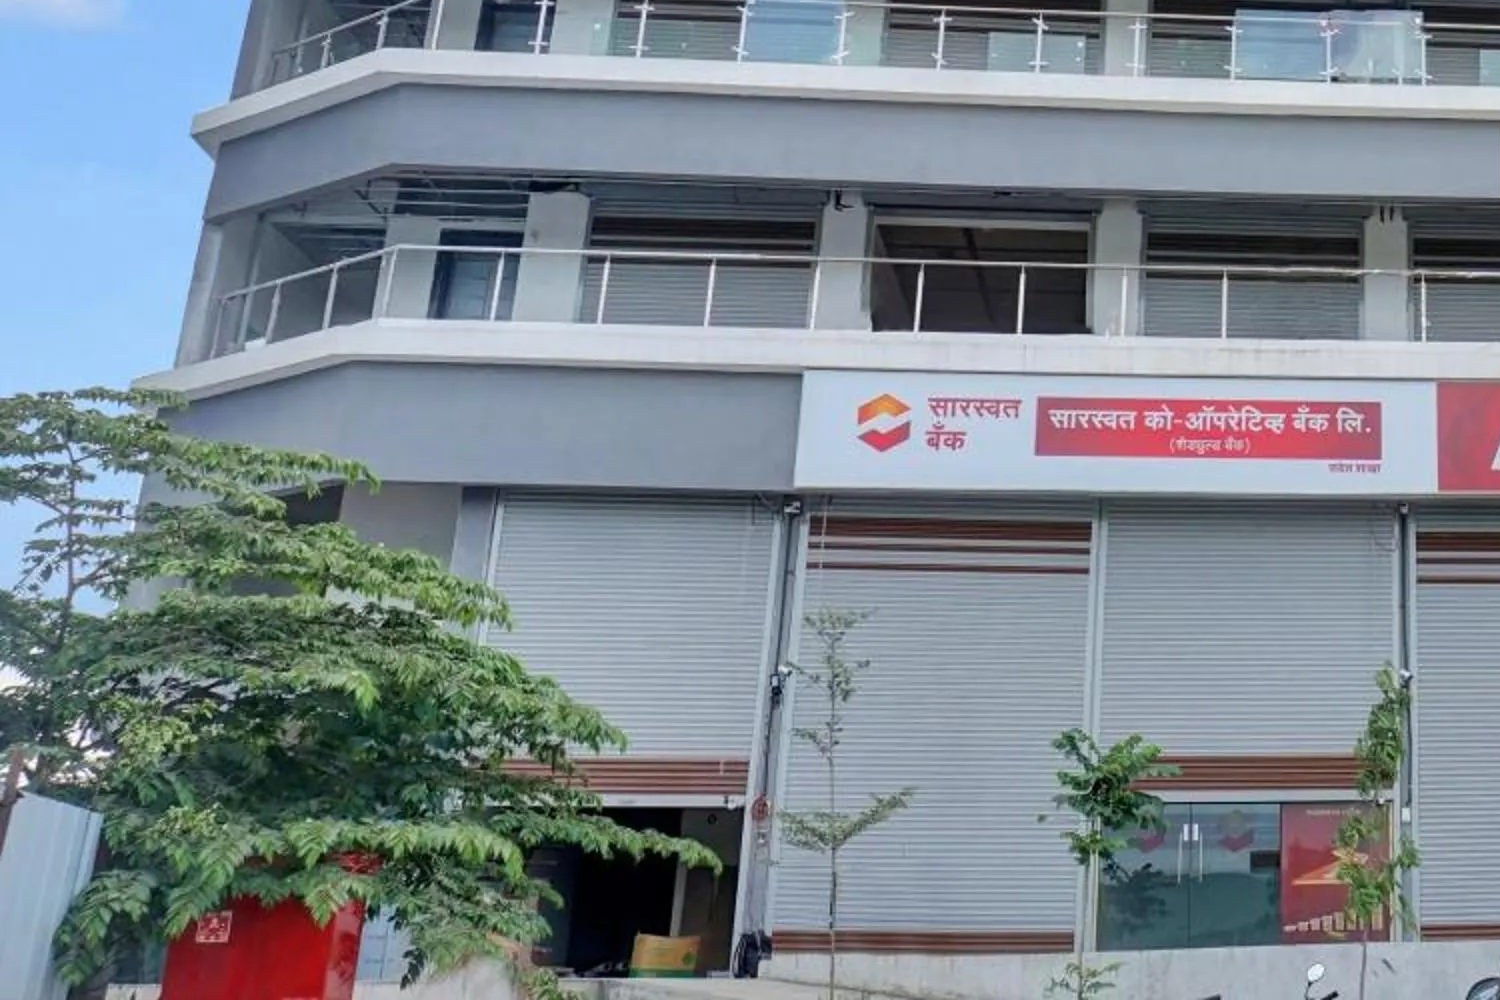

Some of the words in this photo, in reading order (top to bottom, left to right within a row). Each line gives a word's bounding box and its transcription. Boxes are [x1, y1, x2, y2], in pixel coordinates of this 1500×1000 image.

[928, 398, 1022, 418] सारस्वत
[1048, 408, 1136, 431] सारस्वत
[1143, 406, 1286, 434] को-ऑपरेटिव्ह
[1292, 406, 1329, 433] बँक
[1336, 408, 1372, 434] लि.
[925, 421, 967, 451] बँक
